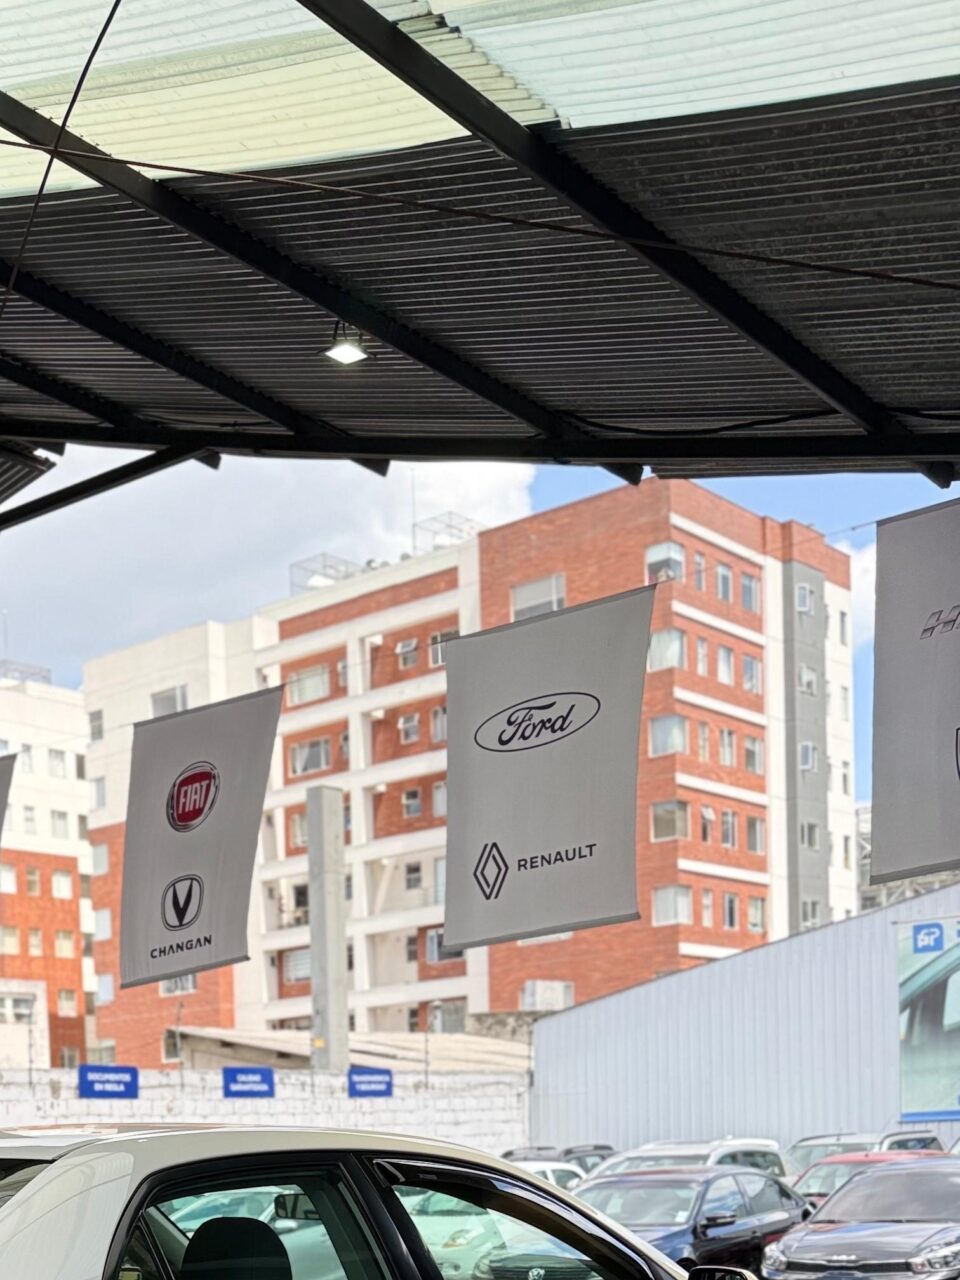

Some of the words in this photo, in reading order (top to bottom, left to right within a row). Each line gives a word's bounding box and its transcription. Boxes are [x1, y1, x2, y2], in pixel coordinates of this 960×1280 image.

[497, 701, 576, 746] Ford
[178, 780, 210, 814] FIAT
[517, 843, 597, 872] RENAULT
[150, 935, 212, 959] CHANGAN
